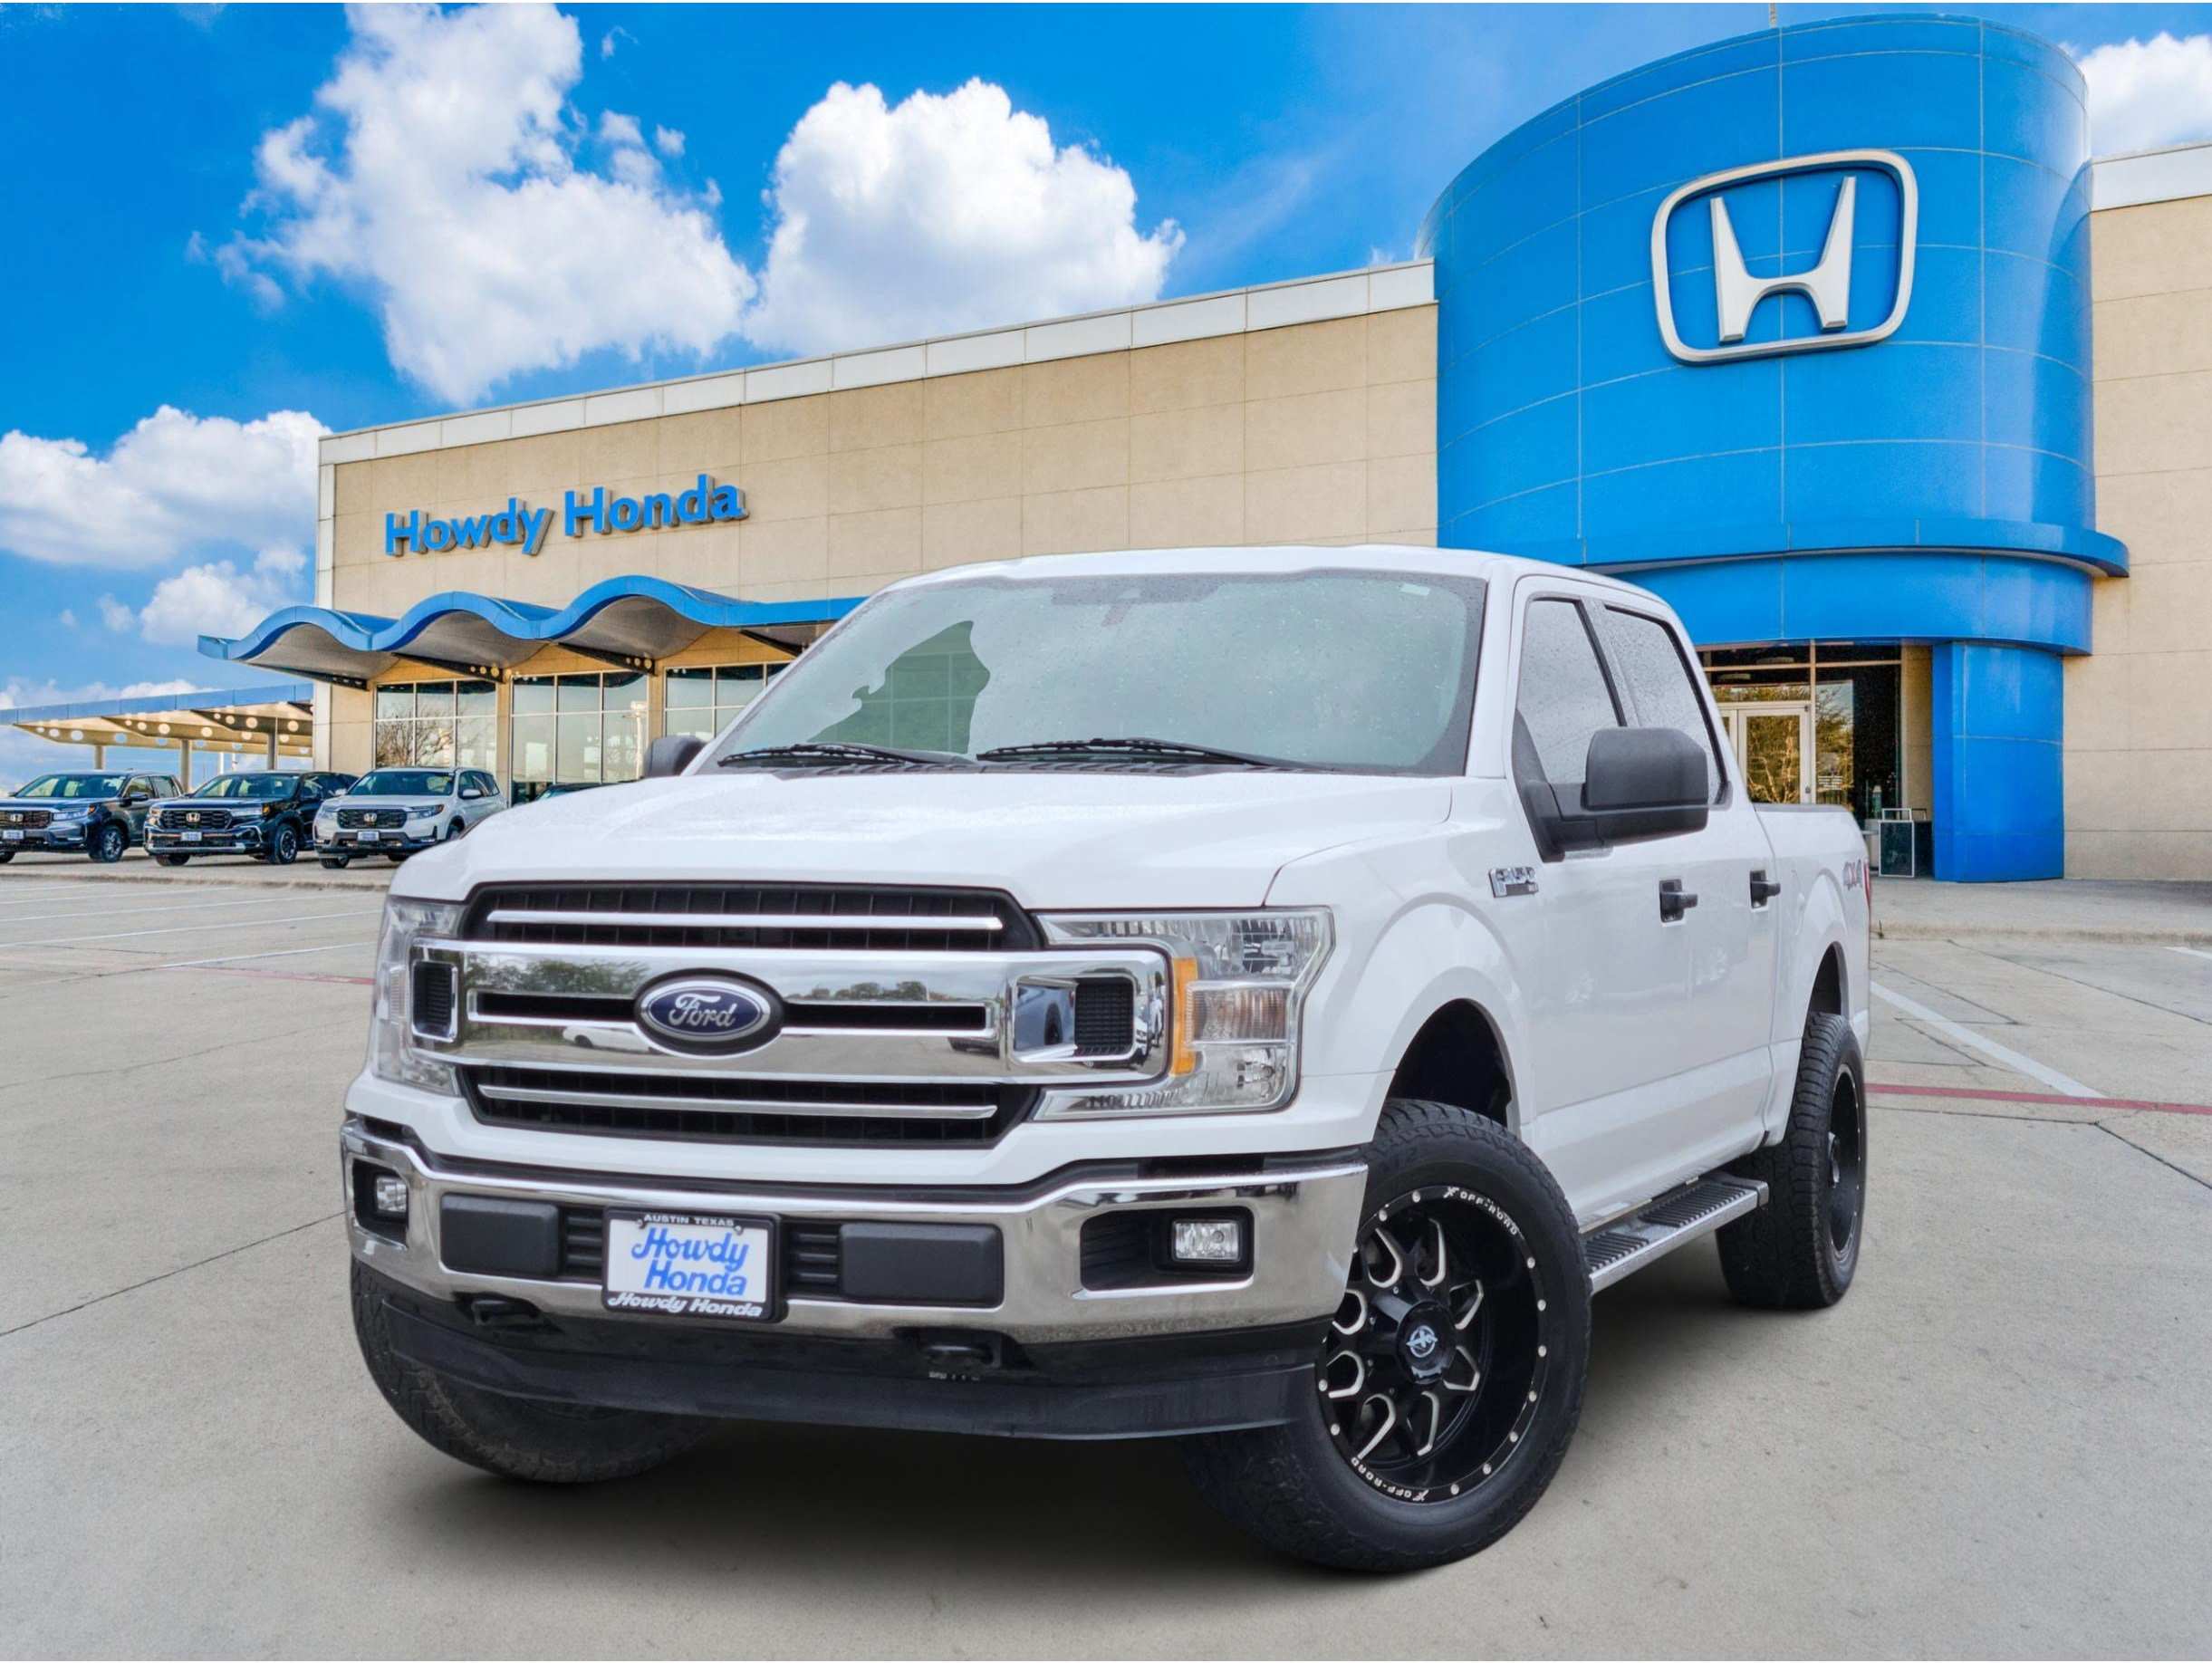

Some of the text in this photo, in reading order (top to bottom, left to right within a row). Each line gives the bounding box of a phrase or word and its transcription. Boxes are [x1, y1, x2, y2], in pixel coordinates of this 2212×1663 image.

[385, 474, 747, 555] Howdy Honda
[668, 994, 737, 1026] Ford
[643, 1214, 735, 1226] AUSTIN TEXAS
[631, 1226, 749, 1272] Howdy
[644, 1260, 748, 1296] Honda
[608, 1293, 763, 1317] Howdy Honda
